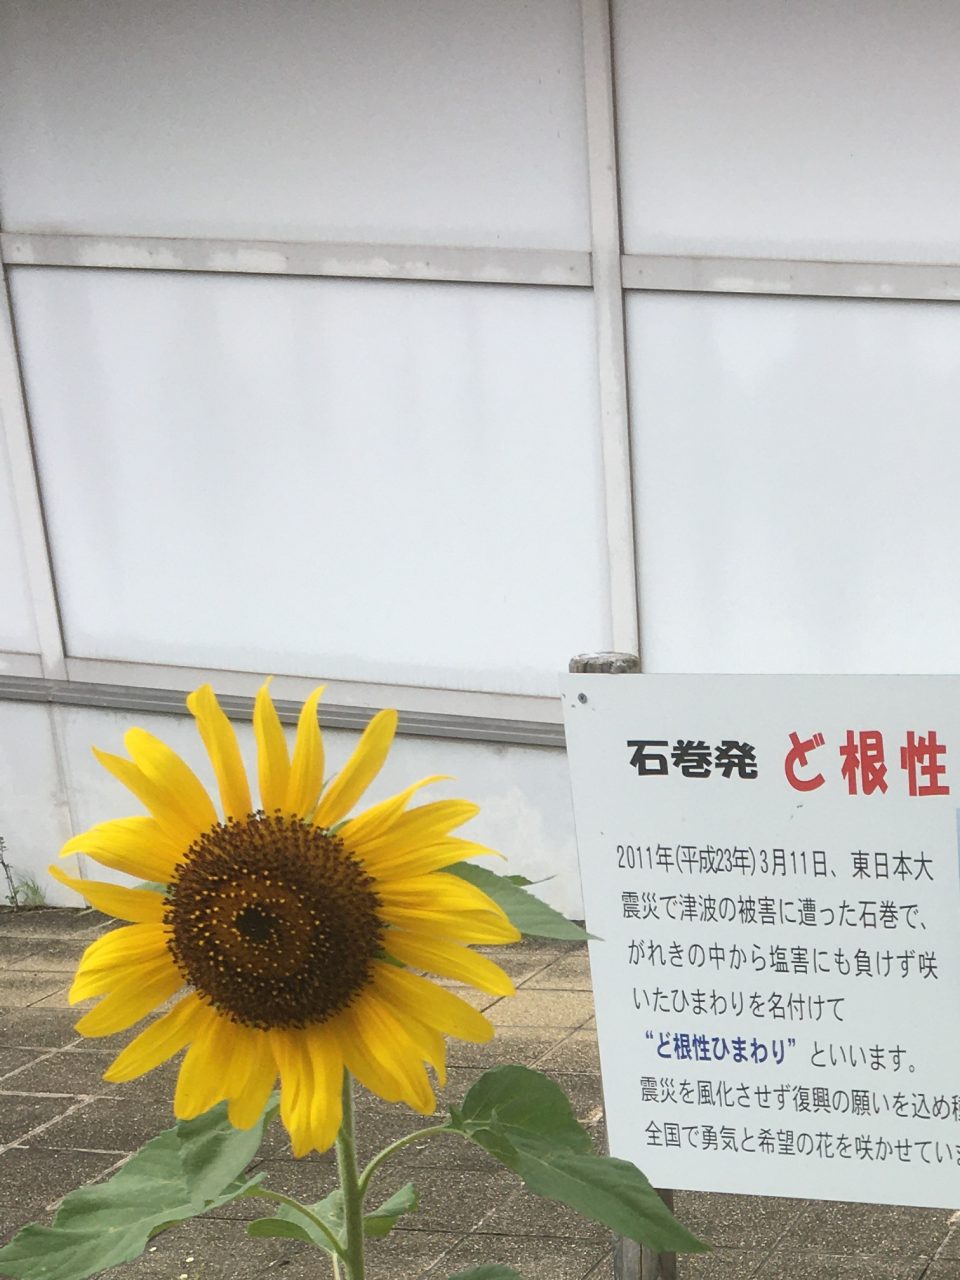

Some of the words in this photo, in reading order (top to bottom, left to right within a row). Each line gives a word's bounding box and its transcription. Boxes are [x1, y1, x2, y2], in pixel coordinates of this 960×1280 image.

[627, 739, 758, 780] 石巻発
[621, 891, 926, 930] 震災で津波の被害に遭った石巻で、
[628, 939, 938, 980] がれきの中から塩害にも負けず咲
[633, 986, 845, 1022] いたひまわりを名付けて
